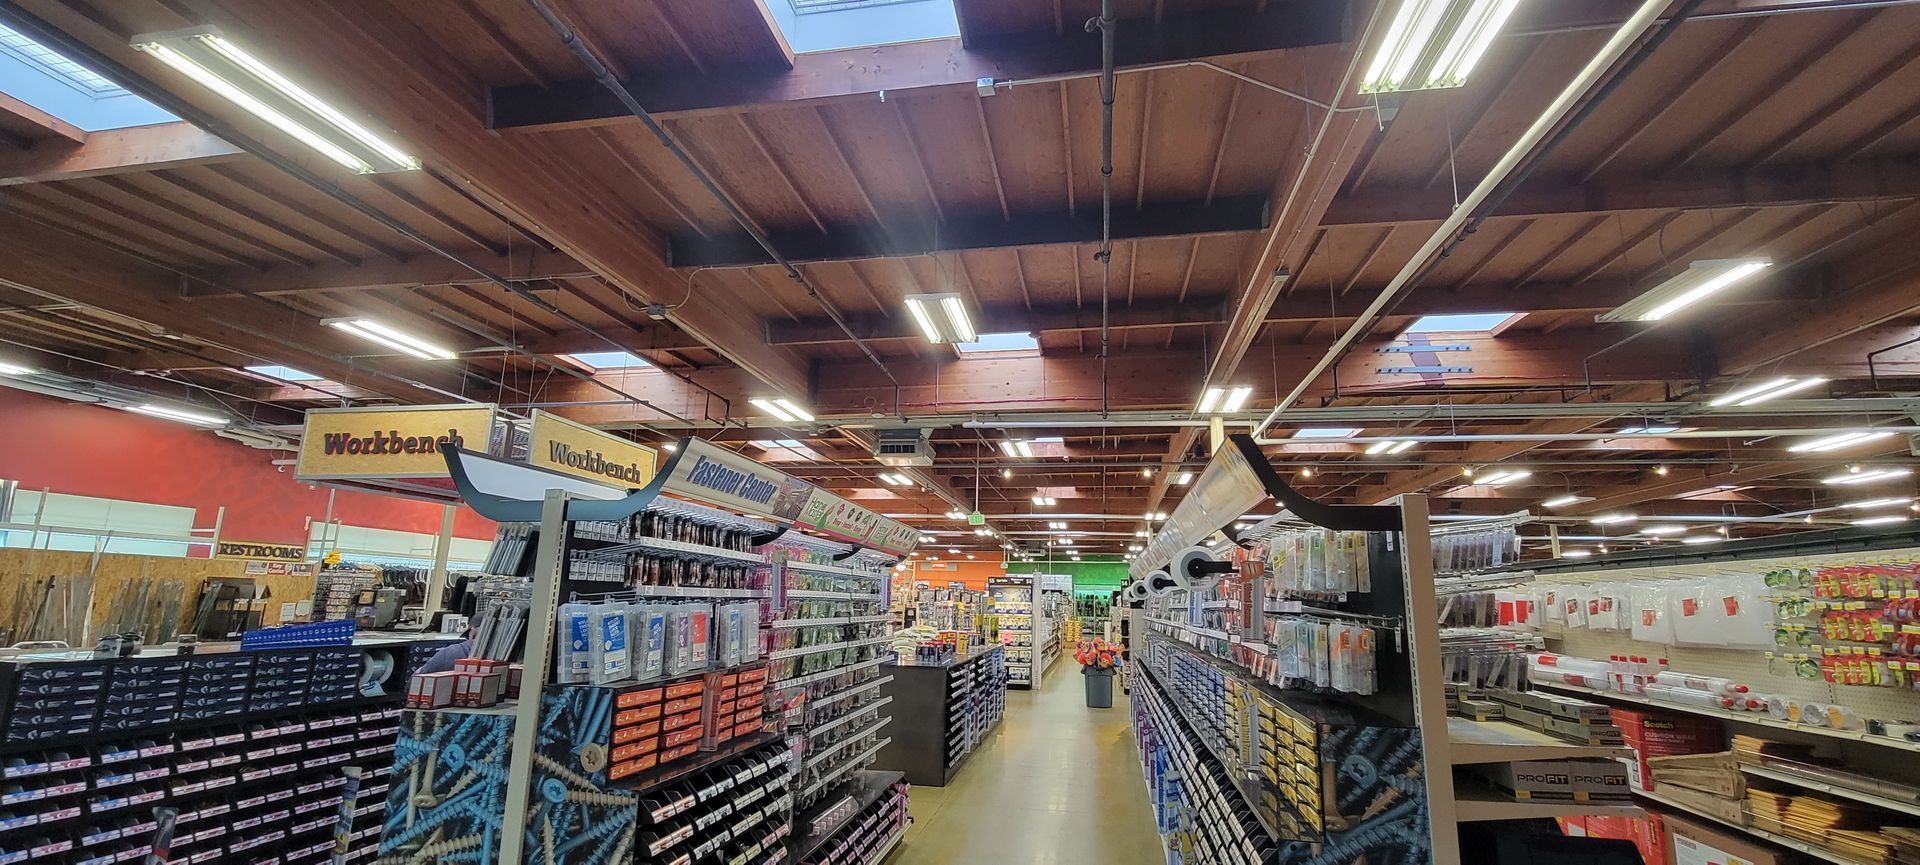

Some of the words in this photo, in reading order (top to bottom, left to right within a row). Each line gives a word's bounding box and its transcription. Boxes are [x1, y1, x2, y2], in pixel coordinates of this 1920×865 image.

[324, 429, 464, 455] Workbench
[549, 440, 641, 484] Workbench
[686, 454, 745, 495] Fastener
[738, 472, 779, 505] Center
[219, 543, 303, 559] RESTROOMS
[1643, 720, 1674, 729] Scotch
[1517, 774, 1568, 785] PROFIT
[1575, 775, 1626, 785] PROFIT
